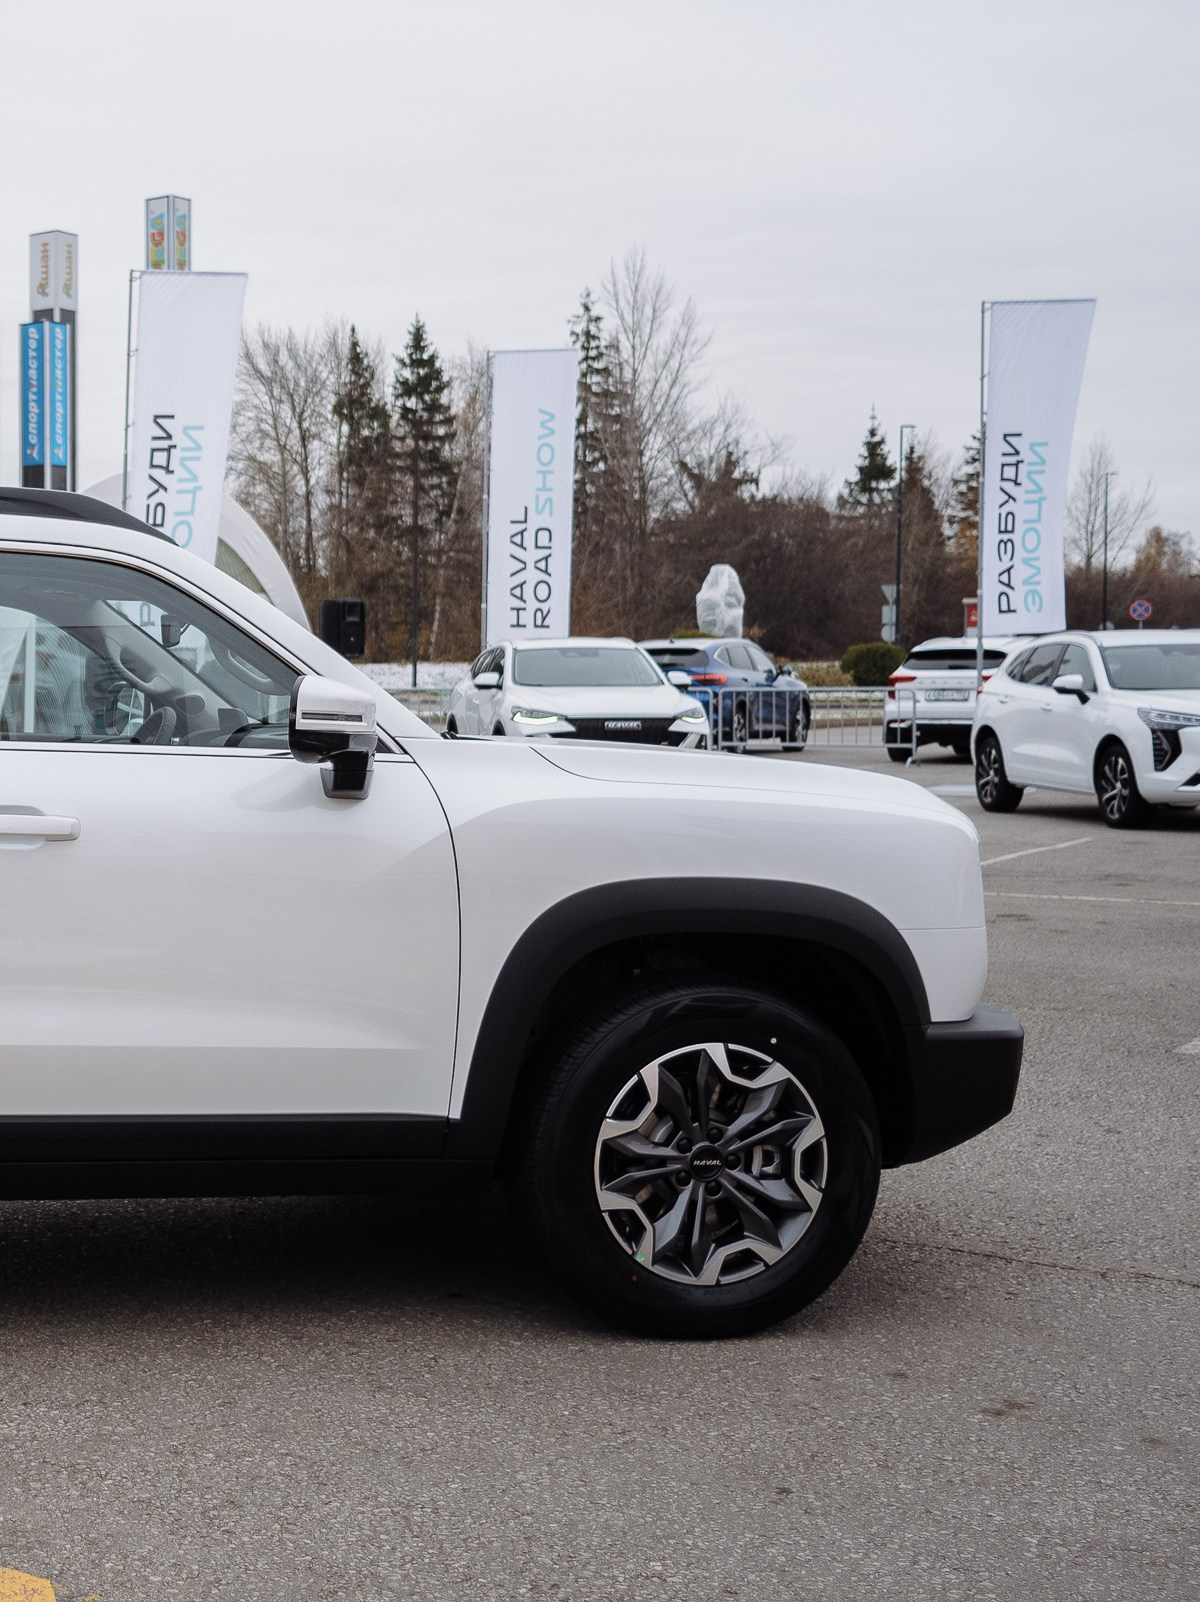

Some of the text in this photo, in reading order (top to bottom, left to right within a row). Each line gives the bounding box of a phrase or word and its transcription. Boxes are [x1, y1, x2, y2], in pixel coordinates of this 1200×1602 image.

[146, 414, 177, 528] БУДИ
[171, 425, 205, 549] ОЦИИ
[533, 408, 556, 629] ROAD SHOW
[997, 432, 1024, 614] РАЗБУДИ
[1021, 441, 1049, 613] ЭМОЦИИ
[509, 505, 528, 628] HAVAL
